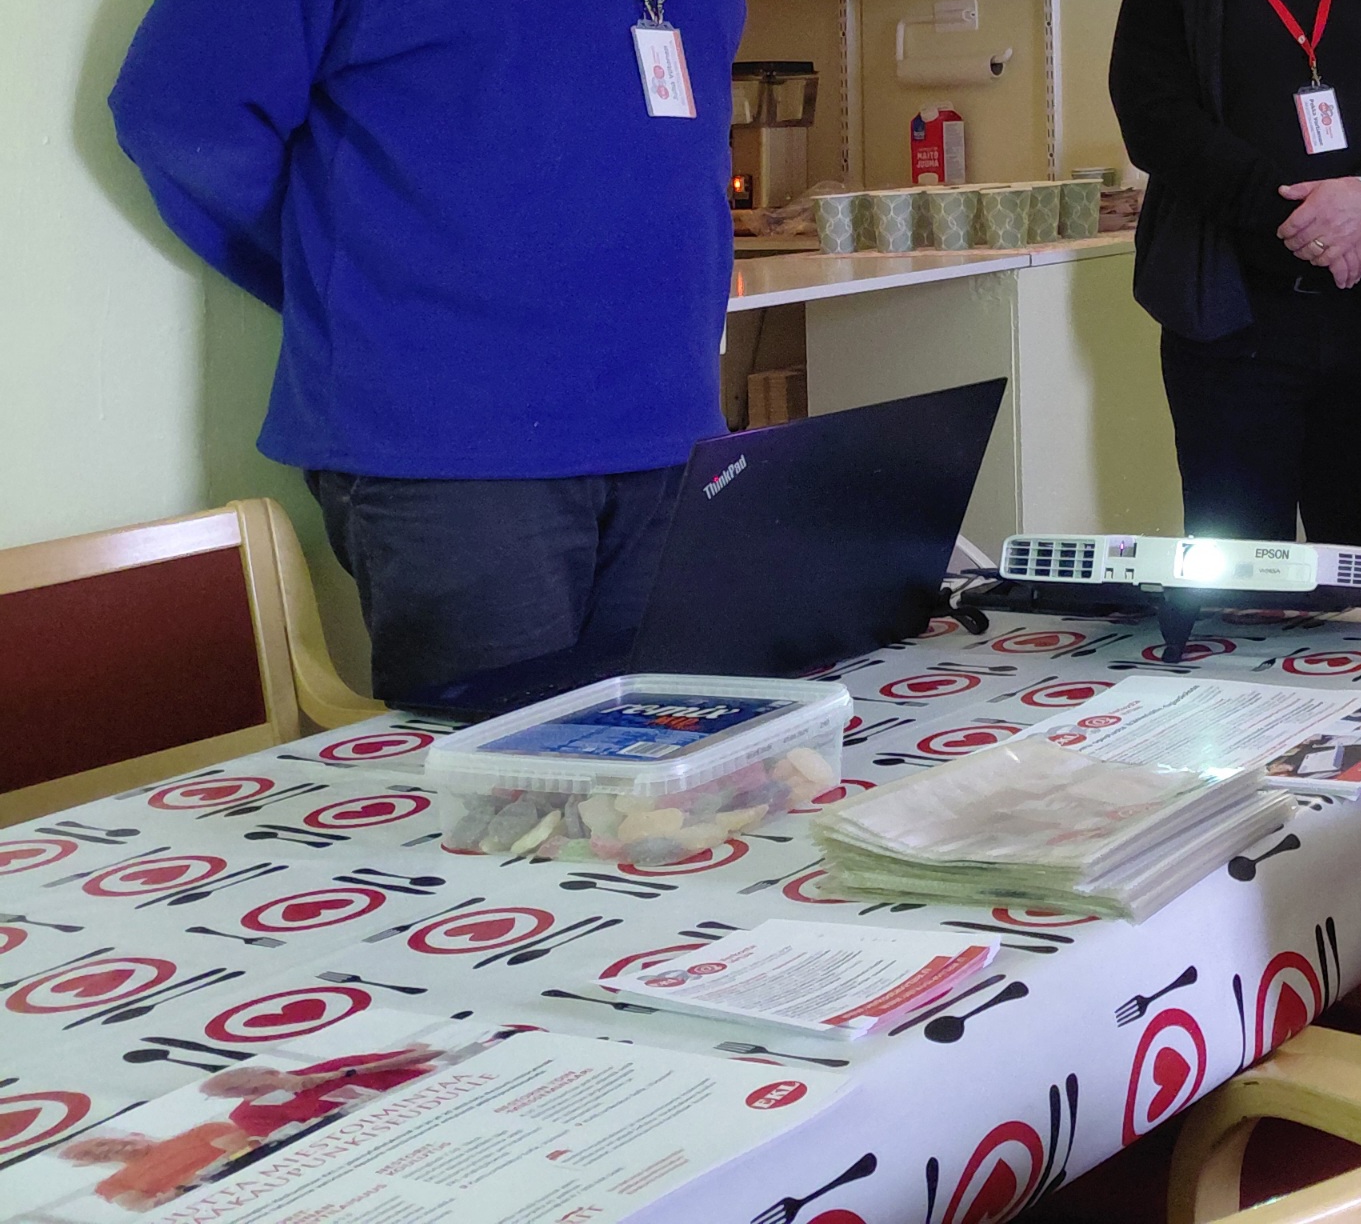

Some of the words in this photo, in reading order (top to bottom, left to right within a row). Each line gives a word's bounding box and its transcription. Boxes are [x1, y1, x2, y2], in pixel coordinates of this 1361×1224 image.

[702, 454, 747, 500] ThinkPad
[1255, 548, 1290, 560] EPSON
[752, 1080, 800, 1109] EKL
[258, 1072, 473, 1178] MIESTOIMINTAA
